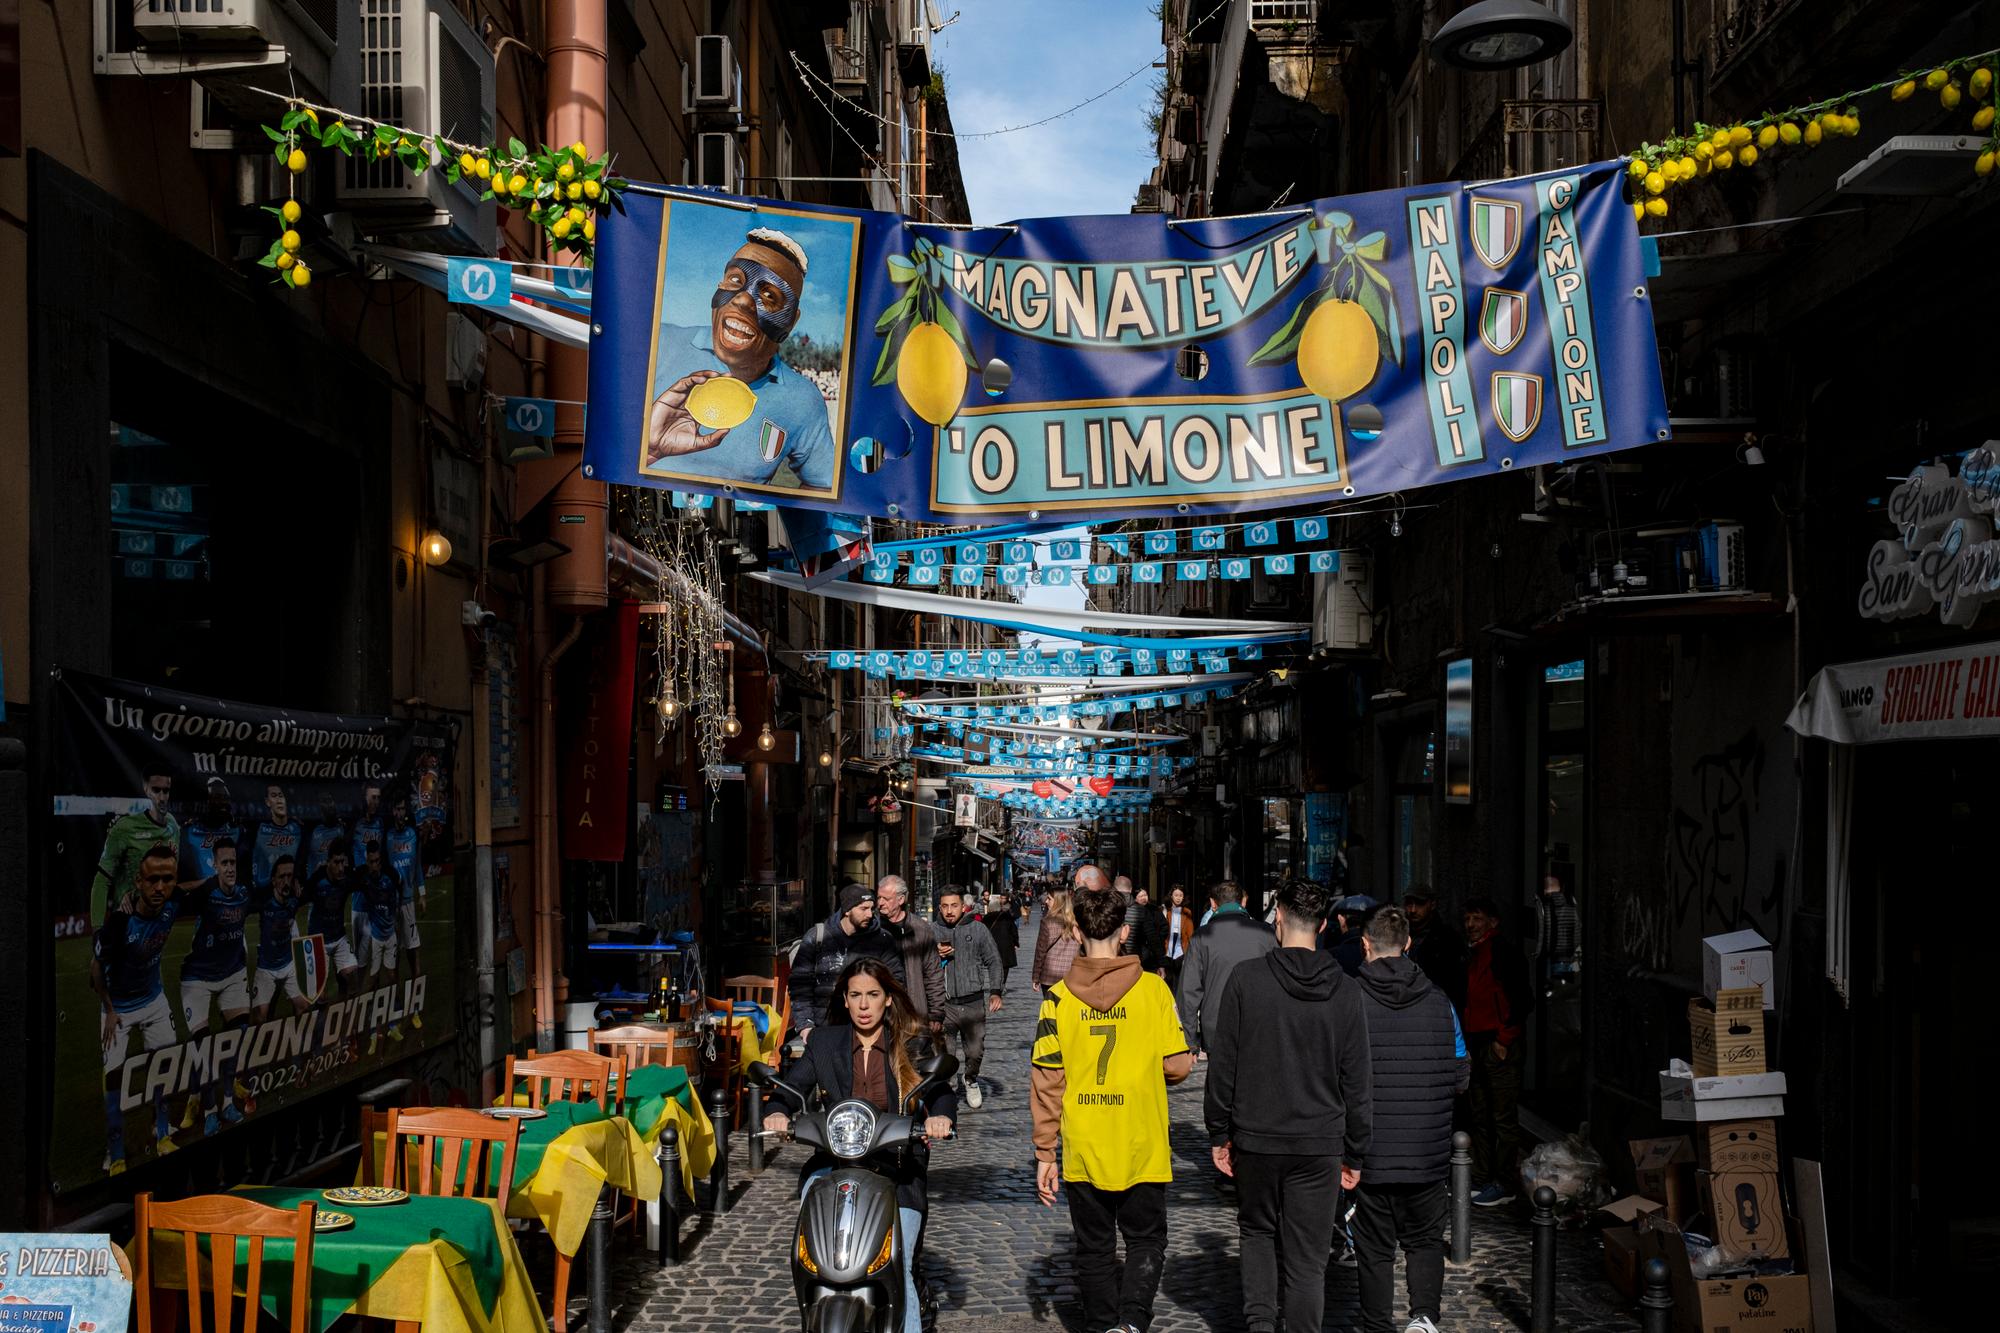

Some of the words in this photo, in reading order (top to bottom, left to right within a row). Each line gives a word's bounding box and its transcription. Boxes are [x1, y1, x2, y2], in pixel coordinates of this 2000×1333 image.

[951, 228, 1299, 340] MAGNATEVE
[1543, 179, 1594, 441] CAMPIONE
[1416, 204, 1466, 458] NAPOLI
[948, 423, 1018, 496] 'O
[1043, 403, 1329, 492] LIMONE
[1862, 550, 1915, 610] San
[1881, 660, 1963, 725] SFOGLIATE
[104, 696, 145, 731] Un
[151, 704, 252, 742] giorno
[255, 719, 390, 754] all'improvviso,
[192, 747, 341, 778] m'innamorai
[340, 755, 359, 779] di
[363, 759, 398, 779] te...
[120, 1009, 320, 1112] CAMPIONI
[321, 974, 427, 1047] D'ITALIA
[1081, 1006, 1127, 1021] KAGAWA
[1090, 1024, 1116, 1085] 7
[1078, 1093, 1124, 1106] DORTMUND
[18, 1248, 110, 1276] PIZZERIA
[22, 1310, 64, 1320] PIZZERIA
[1738, 1309, 1776, 1320] patatine
